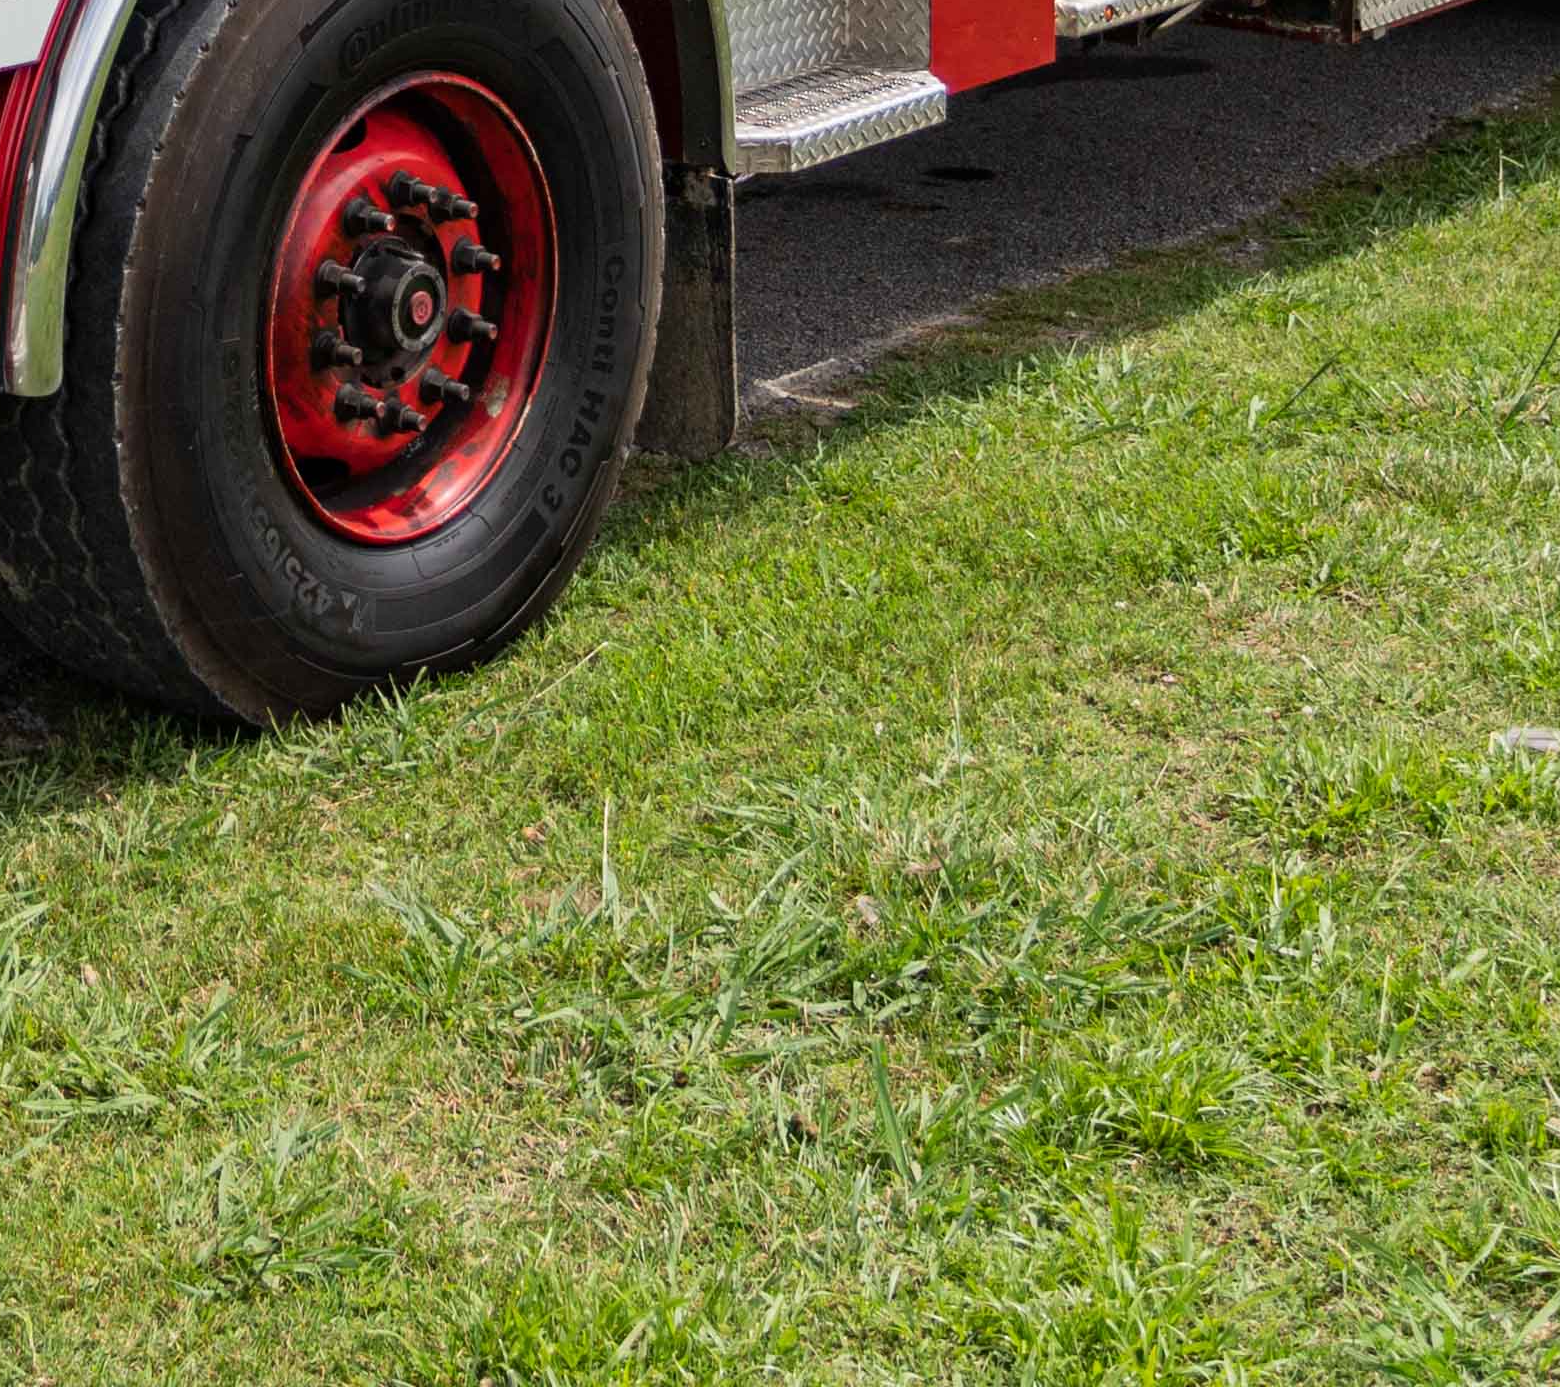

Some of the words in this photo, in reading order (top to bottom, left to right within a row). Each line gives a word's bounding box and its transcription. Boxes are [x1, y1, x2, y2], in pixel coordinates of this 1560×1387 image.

[590, 254, 627, 374] Conti
[559, 388, 607, 479] HAC
[541, 482, 564, 514] 3
